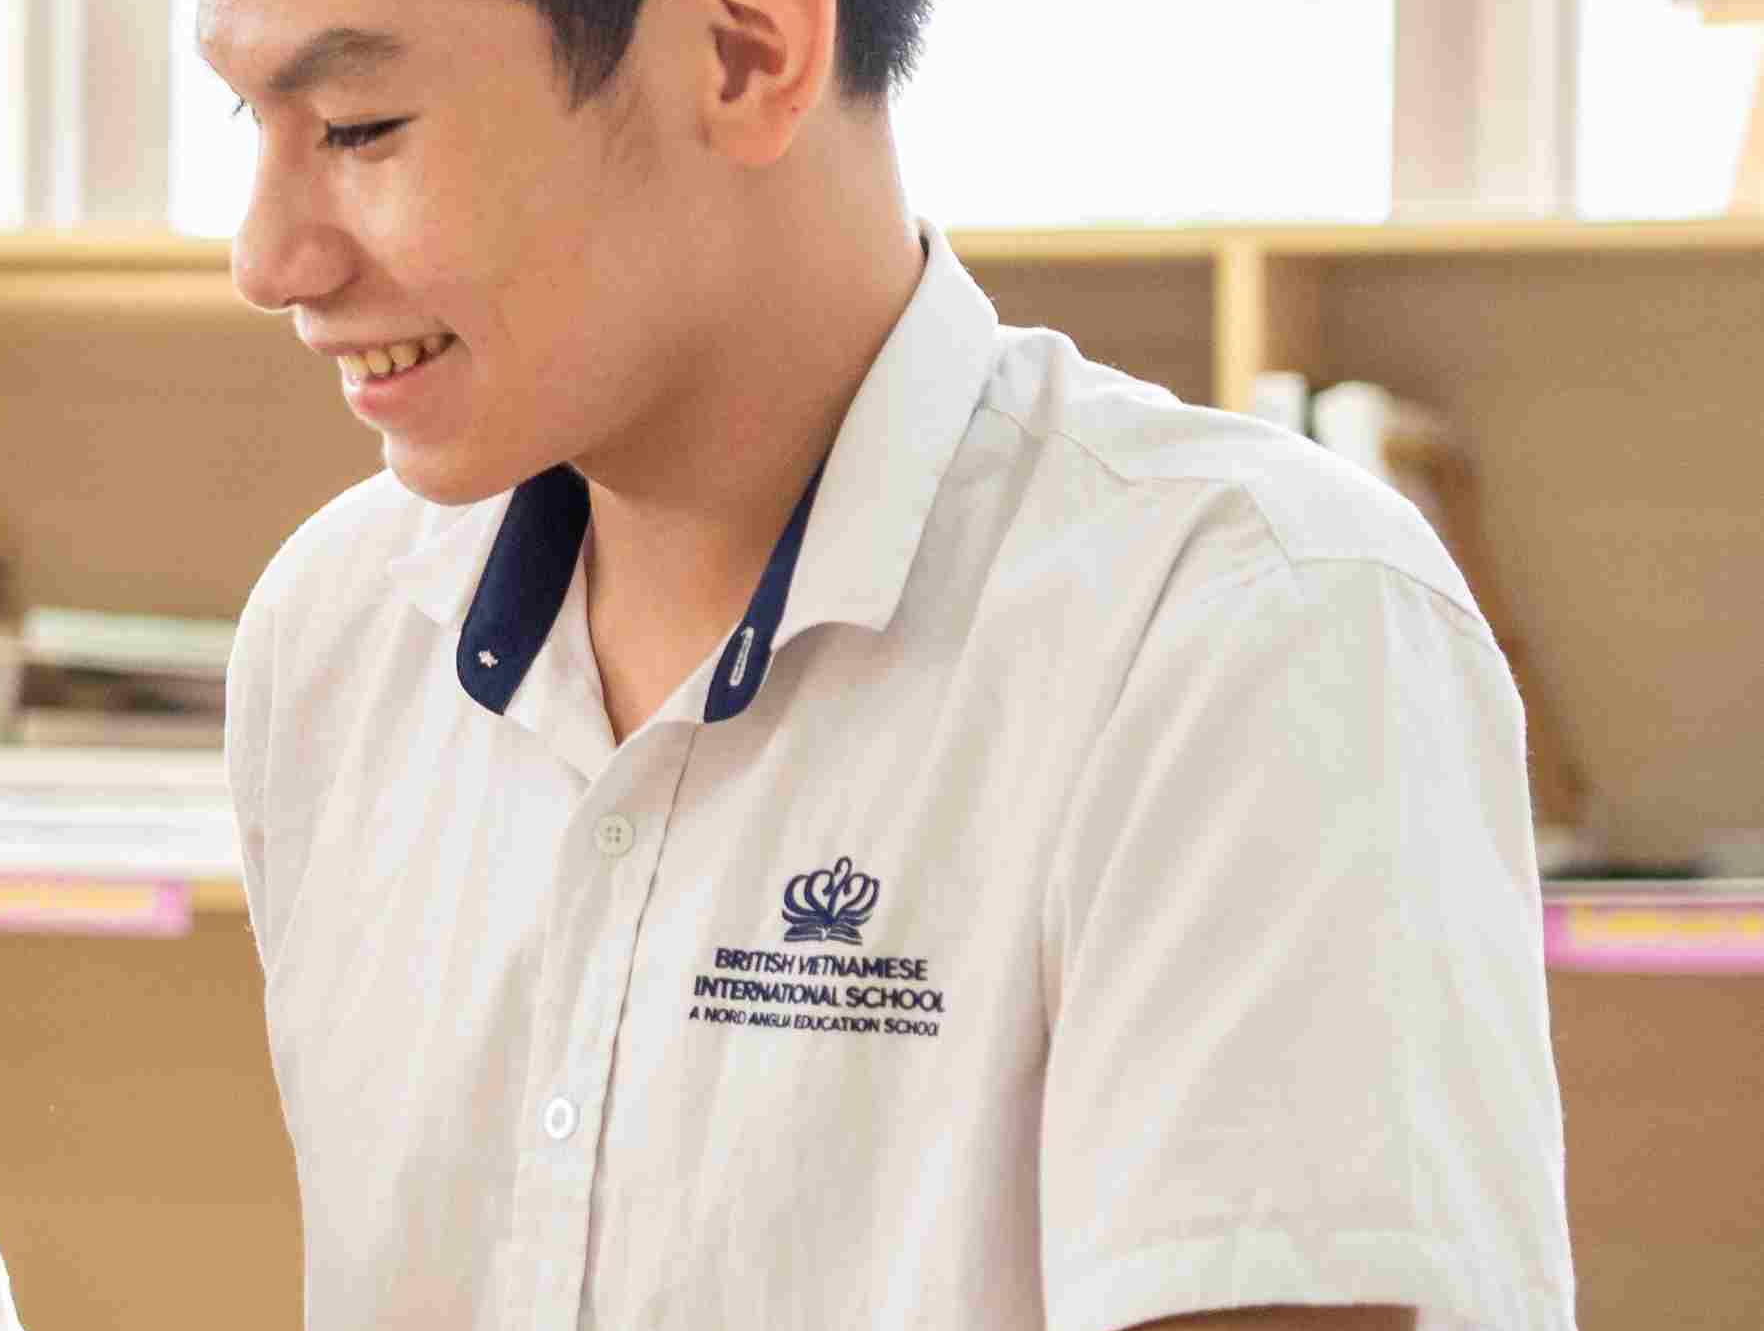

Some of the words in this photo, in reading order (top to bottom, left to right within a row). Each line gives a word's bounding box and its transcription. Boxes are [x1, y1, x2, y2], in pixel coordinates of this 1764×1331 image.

[713, 947, 794, 974] BRITISH
[798, 954, 929, 982] VIETNAMESE
[693, 974, 841, 1007] INTERNATIONAL
[845, 985, 945, 1013] SCHOOL
[688, 1006, 700, 1020] A
[703, 1006, 747, 1025] NORD
[793, 1014, 881, 1033] EDUCATION
